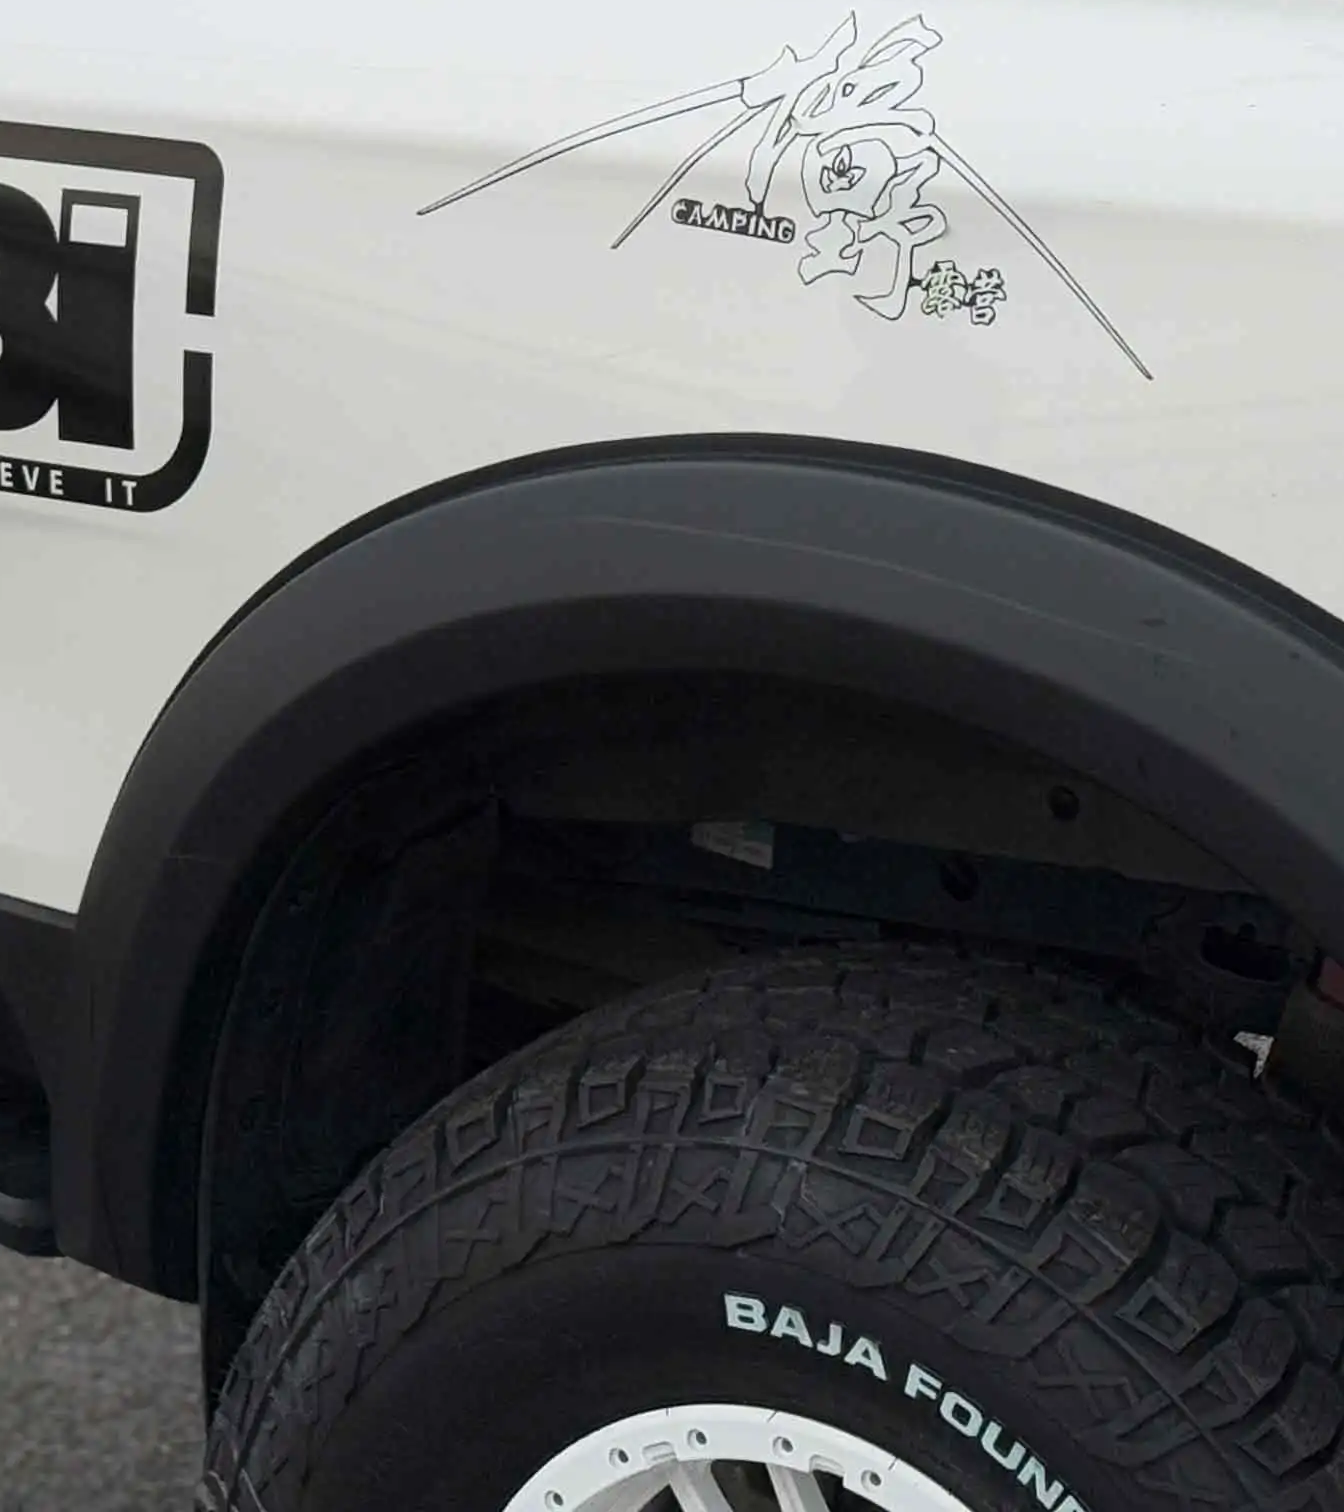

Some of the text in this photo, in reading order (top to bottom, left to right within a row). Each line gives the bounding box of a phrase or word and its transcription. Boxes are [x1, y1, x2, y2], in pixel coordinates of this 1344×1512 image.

[674, 200, 794, 242] CAMPING
[104, 477, 139, 507] IT
[723, 1292, 889, 1381] BAJA
